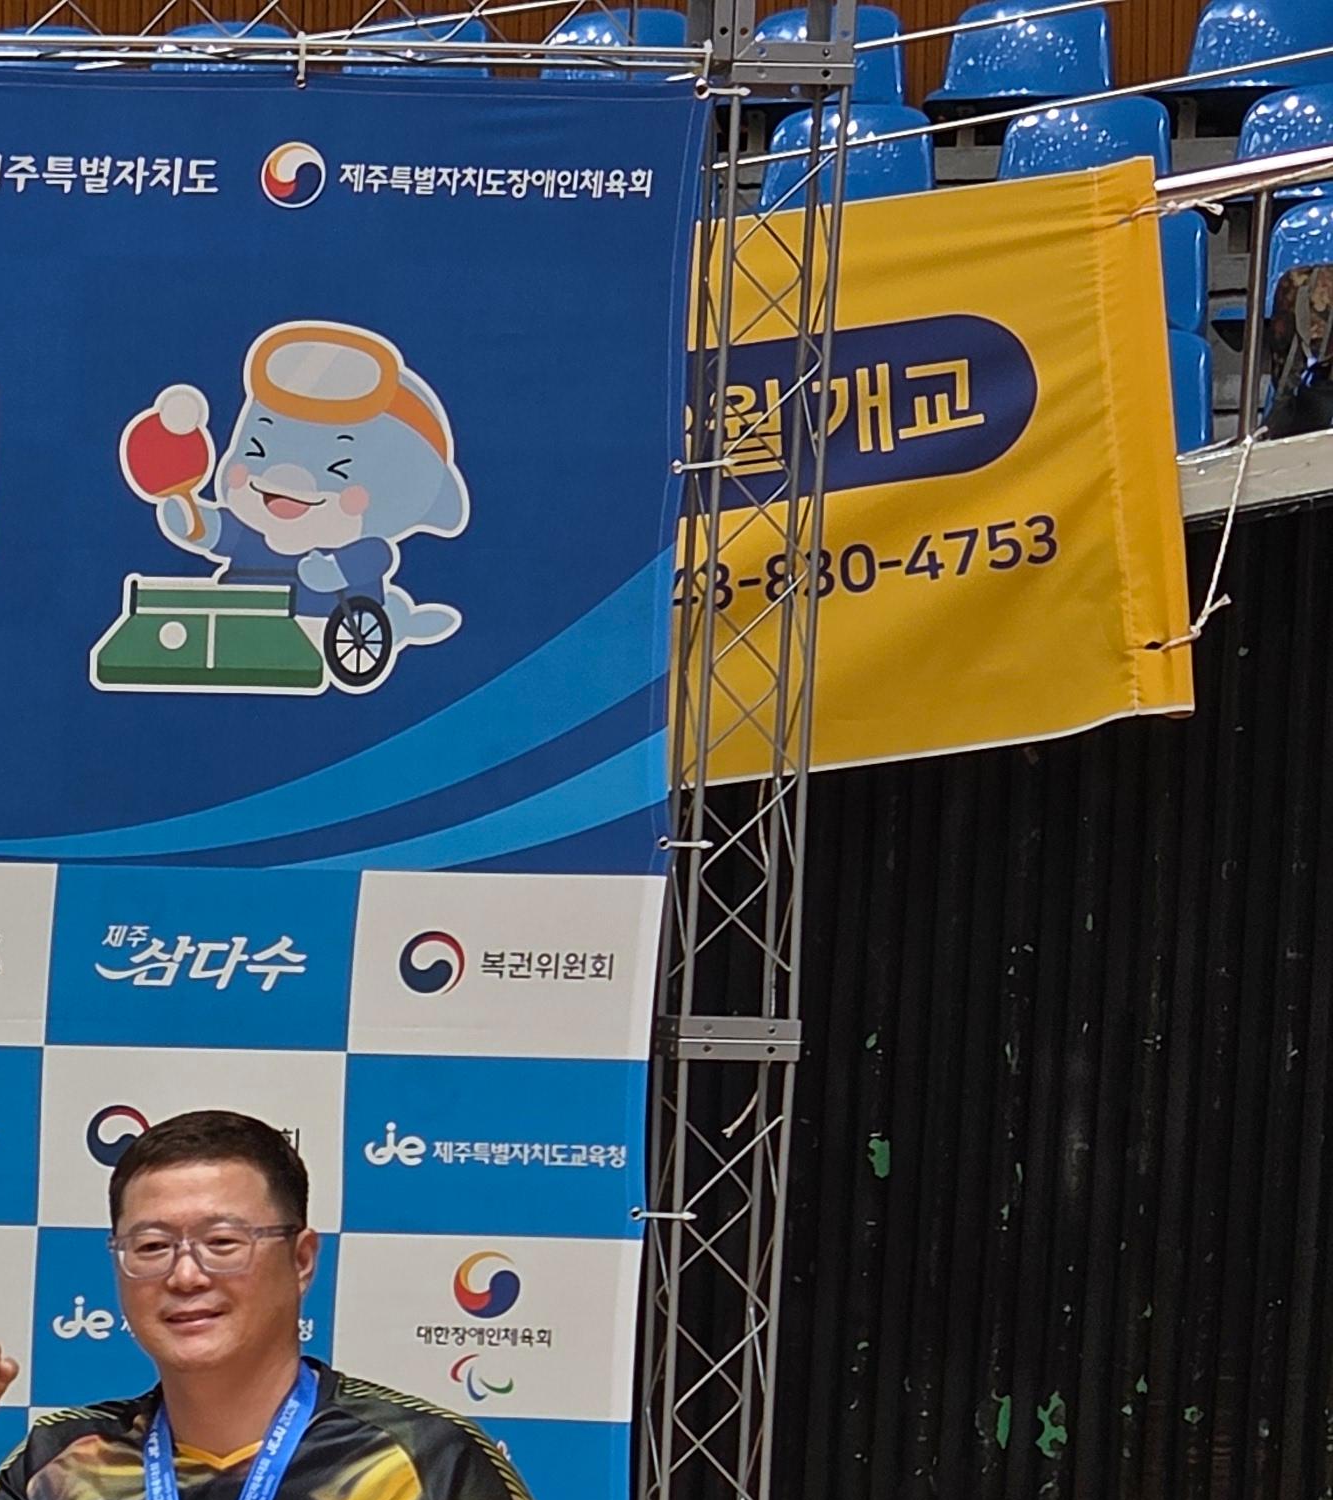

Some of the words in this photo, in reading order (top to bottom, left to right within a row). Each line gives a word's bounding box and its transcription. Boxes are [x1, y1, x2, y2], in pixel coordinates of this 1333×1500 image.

[339, 163, 654, 200] 제주특별자치도장애인체육회
[102, 924, 150, 948] 제주
[96, 935, 307, 992] 삼다수
[480, 950, 615, 982] 복권위원회
[433, 1140, 627, 1168] 제주특별자치도교육청
[416, 1325, 552, 1349] 대한장애인체육회
